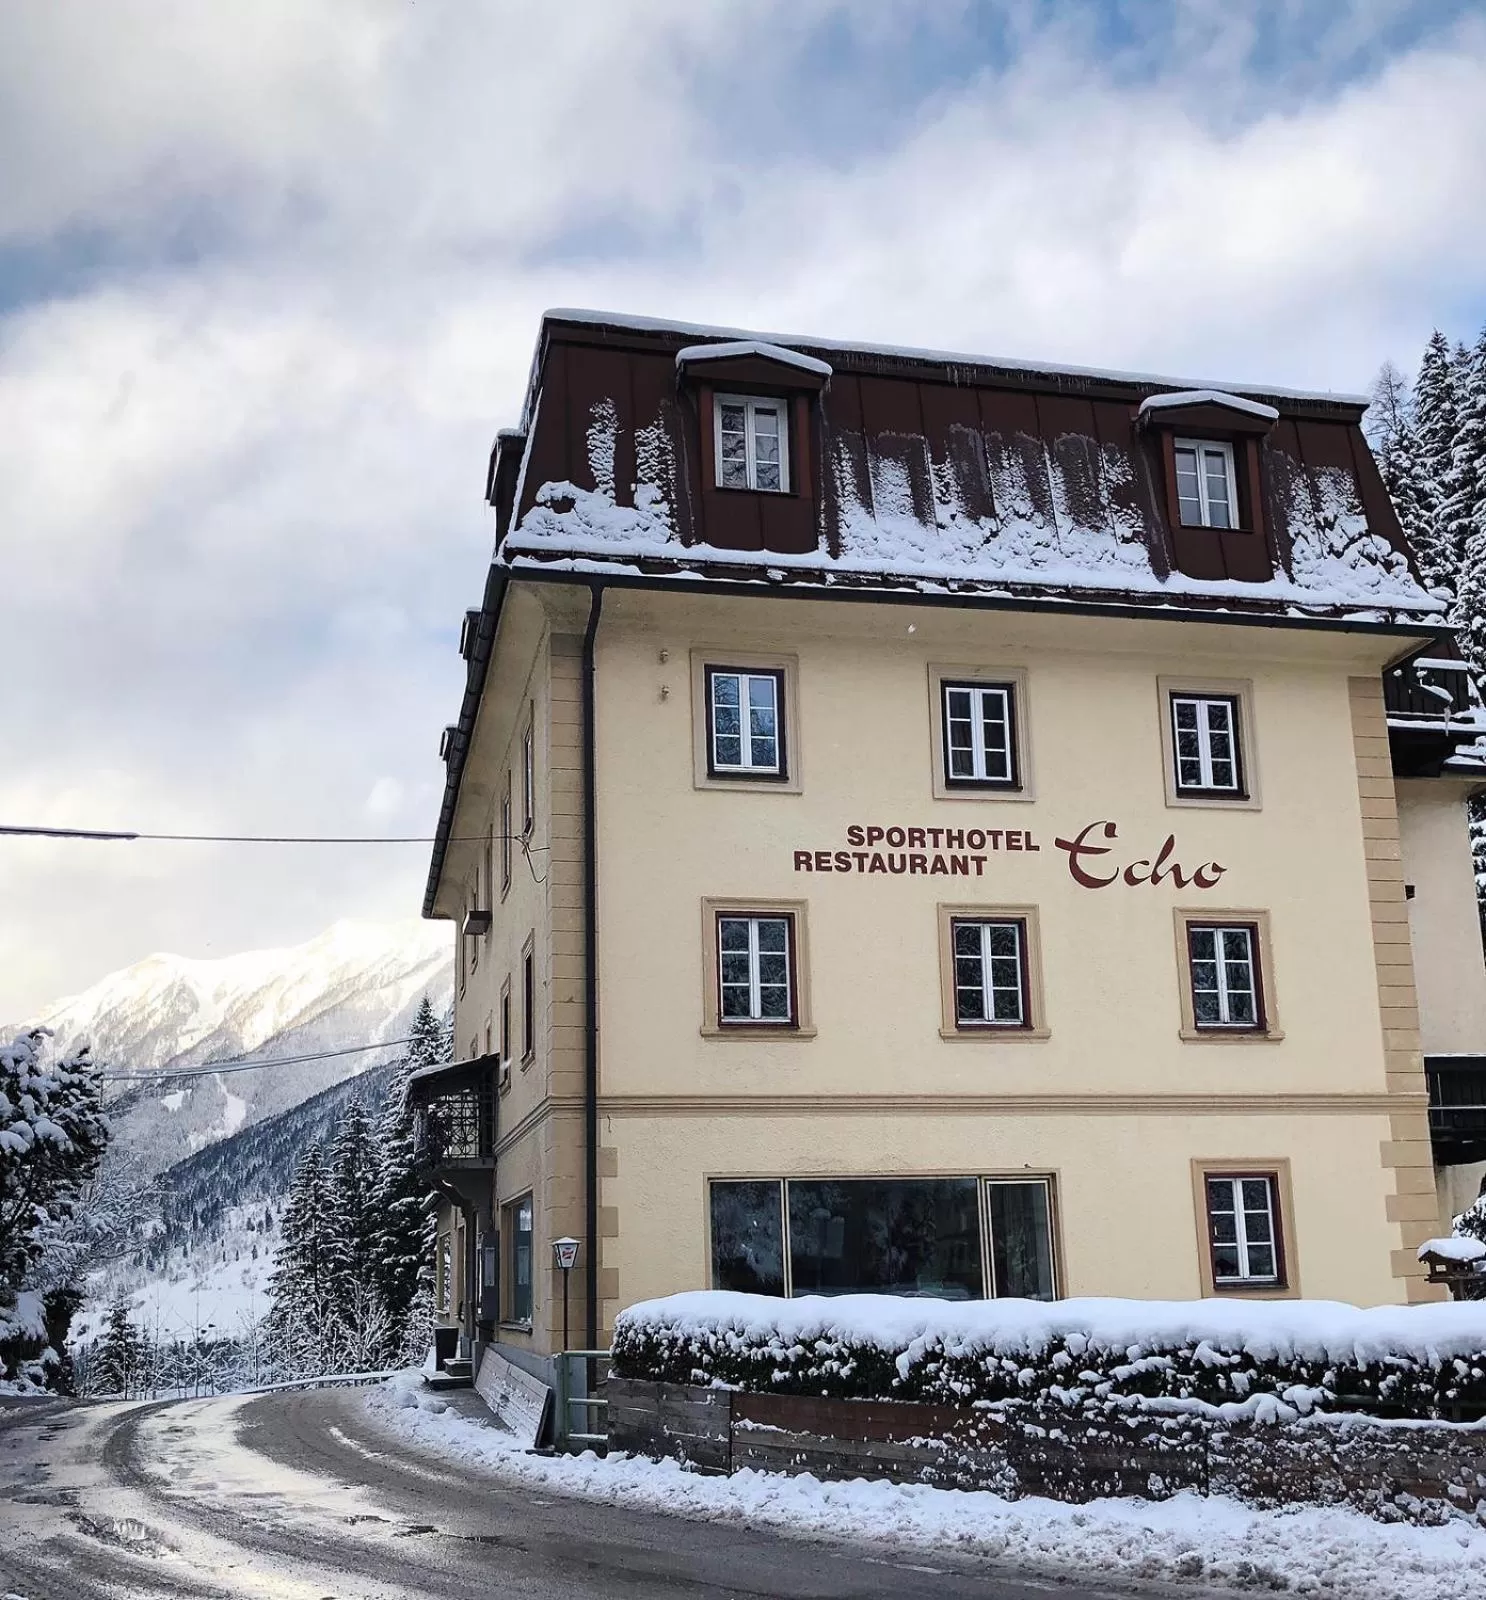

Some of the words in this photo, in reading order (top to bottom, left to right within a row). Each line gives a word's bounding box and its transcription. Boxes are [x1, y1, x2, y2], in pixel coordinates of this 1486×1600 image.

[846, 824, 1041, 852] SPORTHOTEL
[793, 850, 988, 877] RESTAURANT
[1054, 820, 1228, 890] Echo
